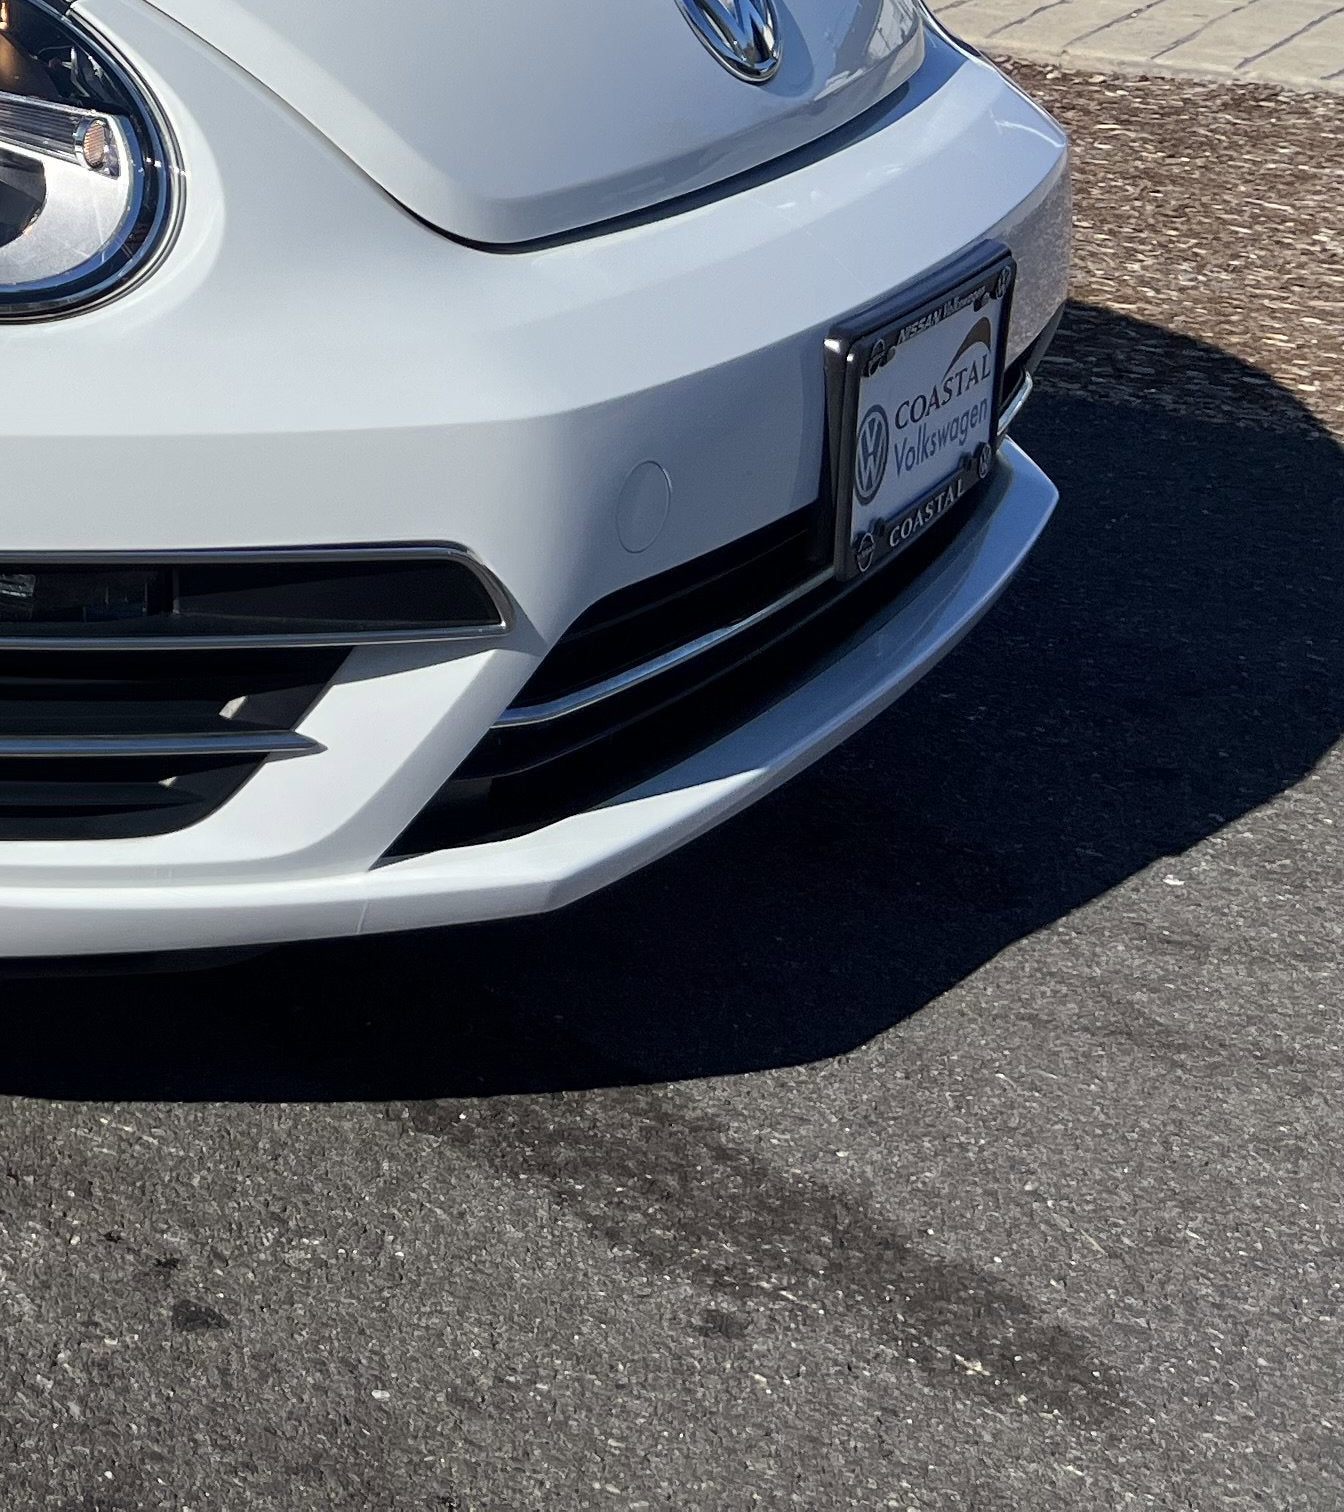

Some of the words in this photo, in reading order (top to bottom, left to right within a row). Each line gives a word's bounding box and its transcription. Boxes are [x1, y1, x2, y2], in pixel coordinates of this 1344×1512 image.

[894, 353, 992, 431] COASTAL
[894, 398, 988, 479] Volkswagen
[889, 478, 965, 548] COASTAL
